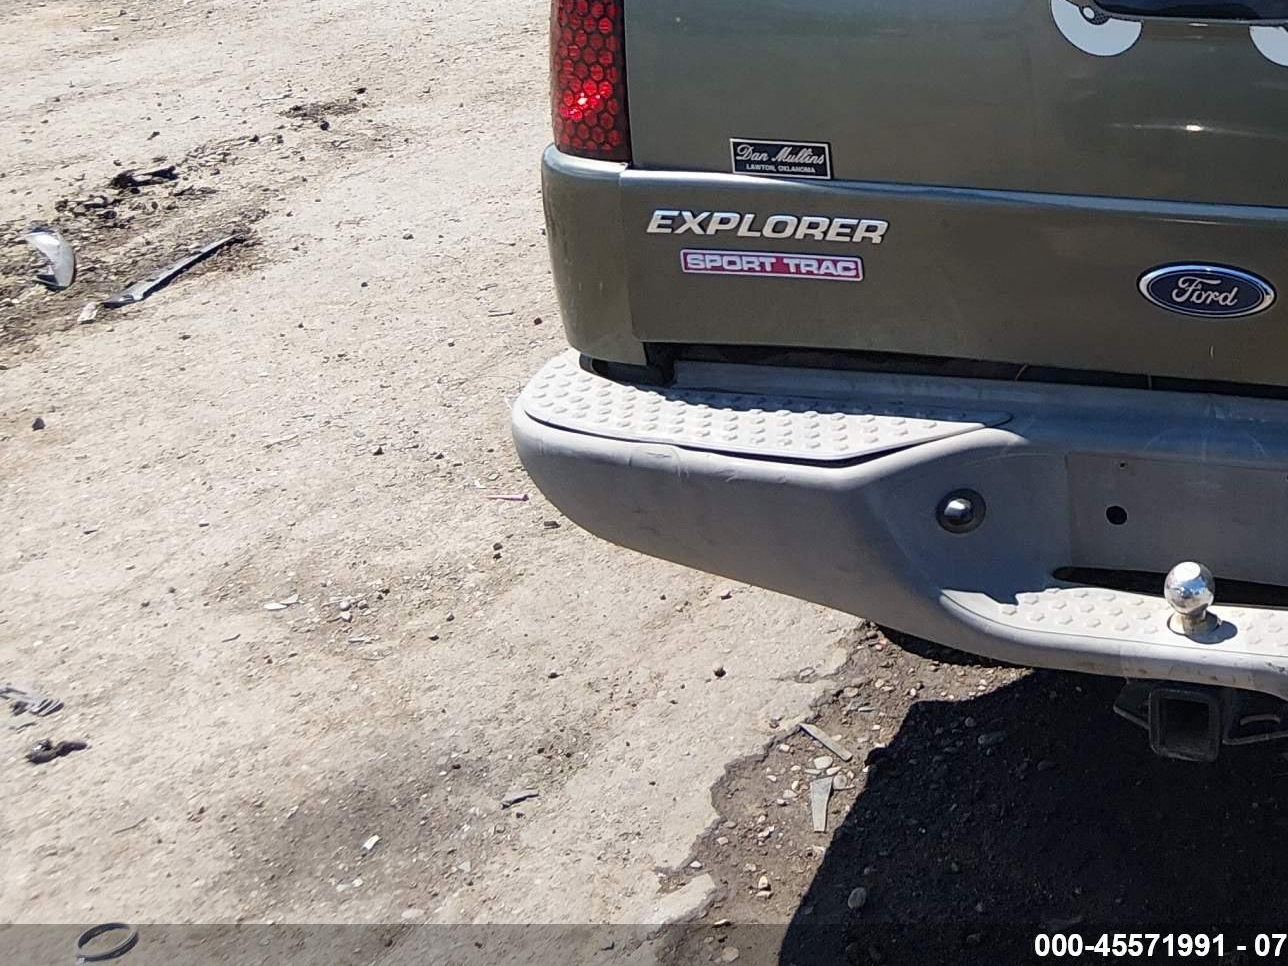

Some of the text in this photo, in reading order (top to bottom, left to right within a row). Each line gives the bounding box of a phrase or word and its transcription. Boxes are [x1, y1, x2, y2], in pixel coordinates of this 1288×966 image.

[735, 144, 825, 165] Dan Mullins
[778, 165, 816, 174] OKLAHOMA
[646, 209, 889, 244] EXPLORER
[686, 253, 858, 277] SPORT TRAC
[1171, 275, 1239, 307] Ford
